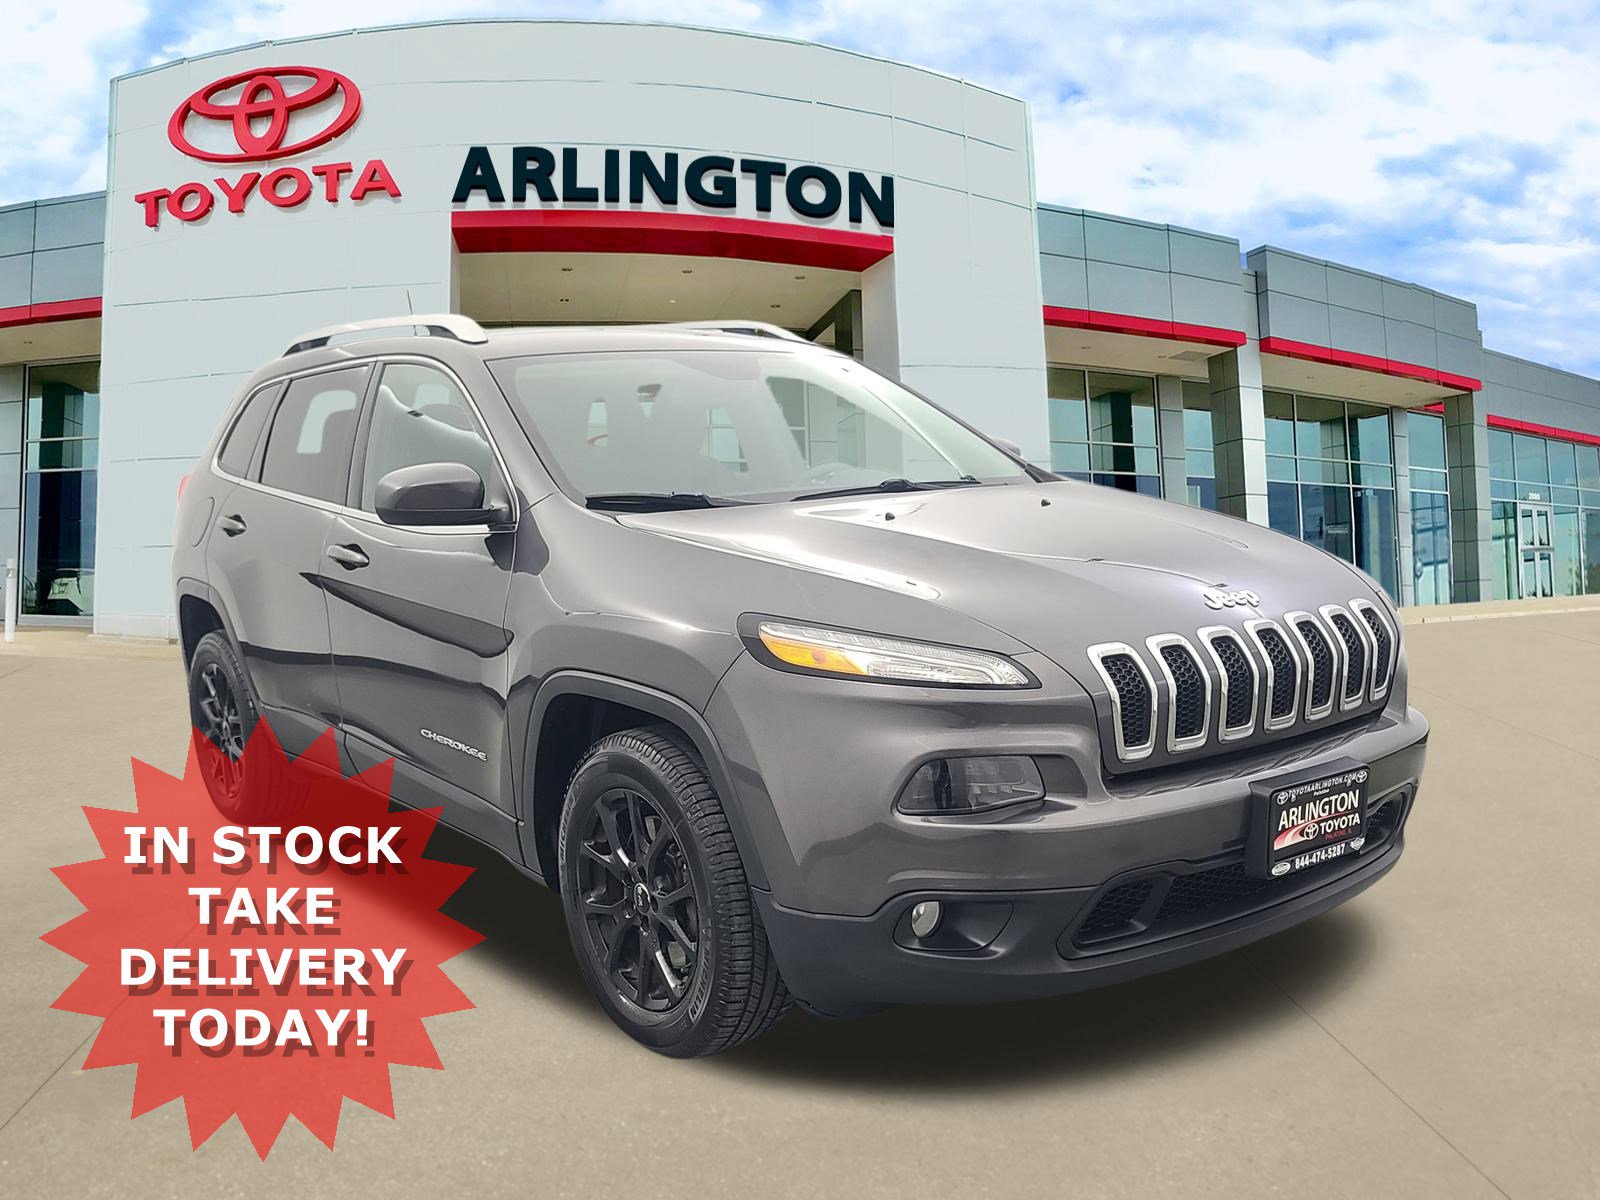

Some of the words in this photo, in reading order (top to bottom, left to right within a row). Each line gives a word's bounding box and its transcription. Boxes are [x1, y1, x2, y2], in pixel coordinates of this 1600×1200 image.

[135, 159, 402, 228] TOYOTA
[452, 146, 895, 227] ARLINGTON
[1203, 590, 1261, 611] Jeep
[420, 728, 488, 762] CHEROKEE
[1278, 789, 1360, 831] ARLINGTON
[1320, 813, 1361, 834] TOYOTA
[1295, 843, 1346, 869] 844-474-5287
